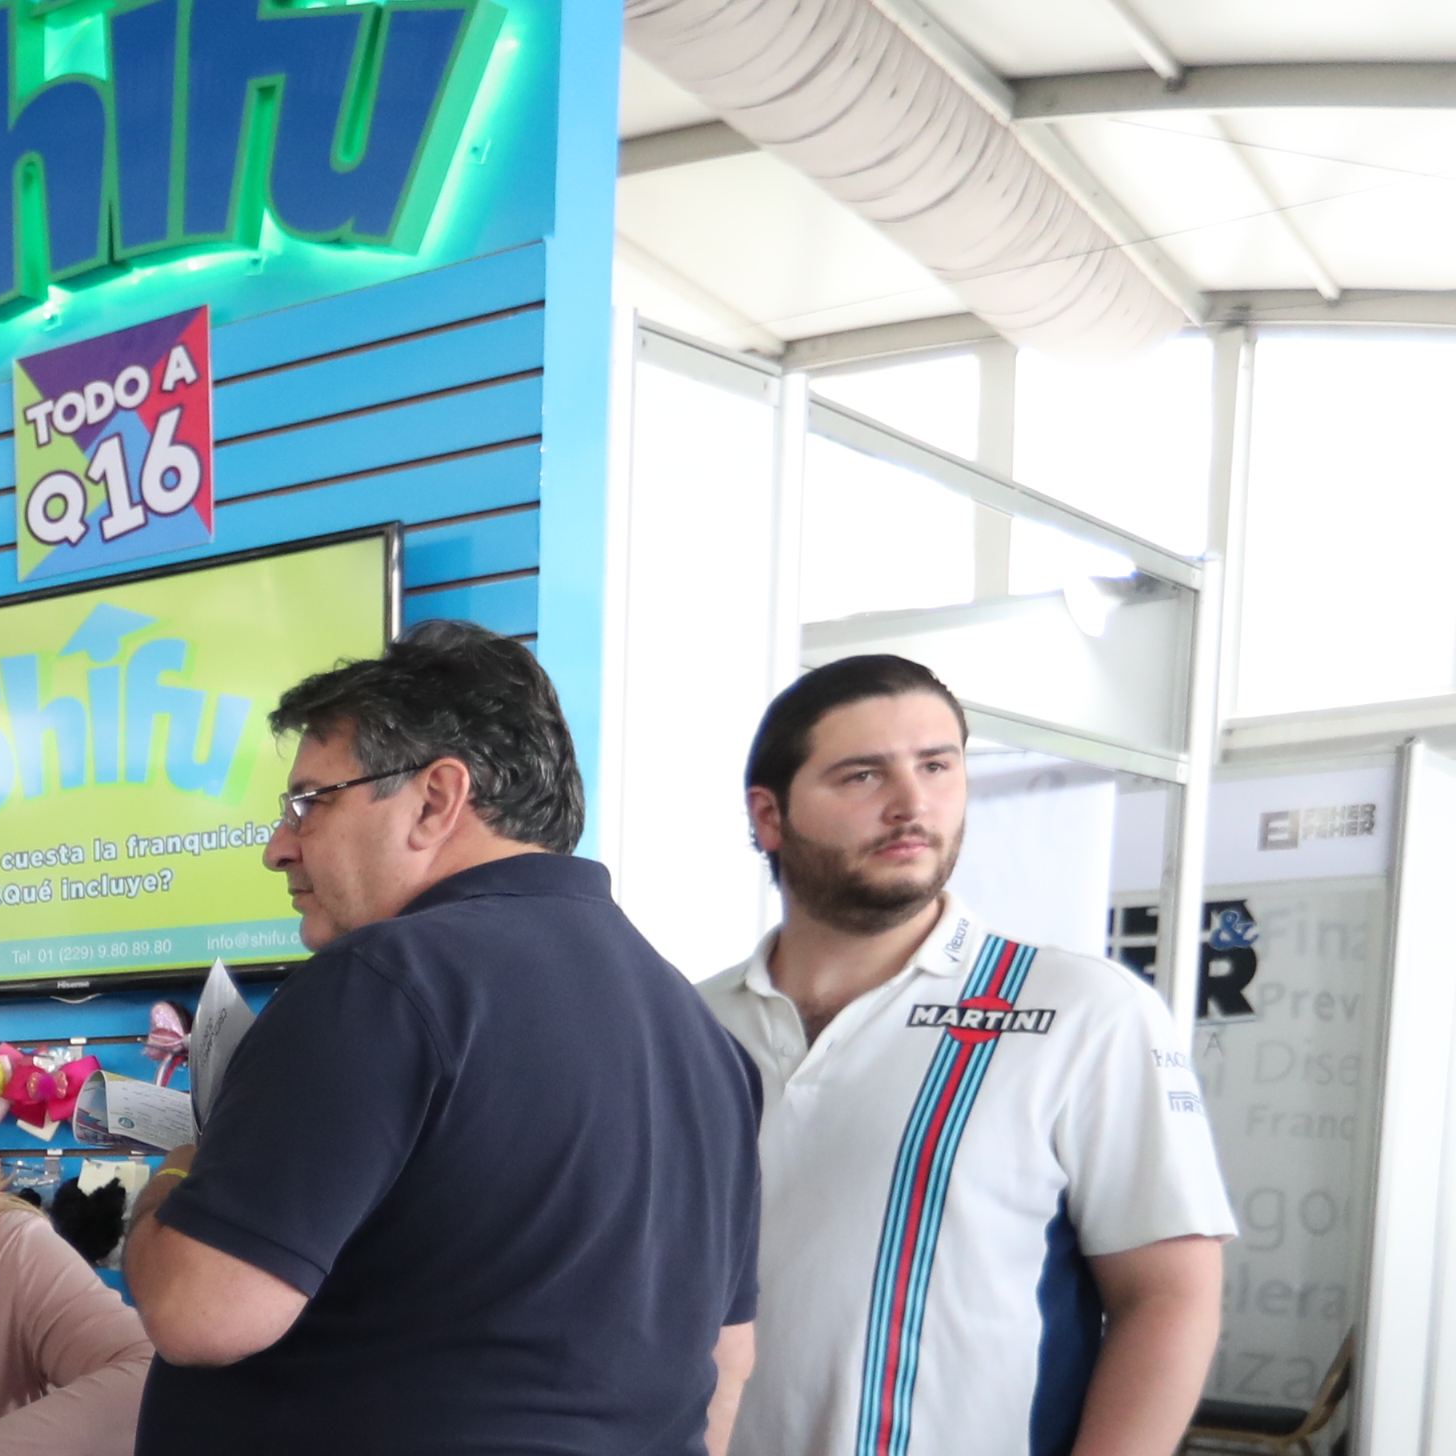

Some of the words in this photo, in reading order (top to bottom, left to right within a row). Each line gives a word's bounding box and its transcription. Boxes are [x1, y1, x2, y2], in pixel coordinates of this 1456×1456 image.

[24, 364, 151, 447] TODO
[160, 344, 199, 393] A
[25, 404, 202, 547] Q16
[0, 843, 85, 872] cuesta
[93, 838, 118, 862] la
[60, 868, 174, 899] incluye?
[38, 948, 53, 963] 01
[59, 946, 93, 964] (229)
[97, 939, 172, 959] 9.80.89.80
[945, 917, 970, 955] Rexona
[910, 1005, 1052, 1032] MARTINI
